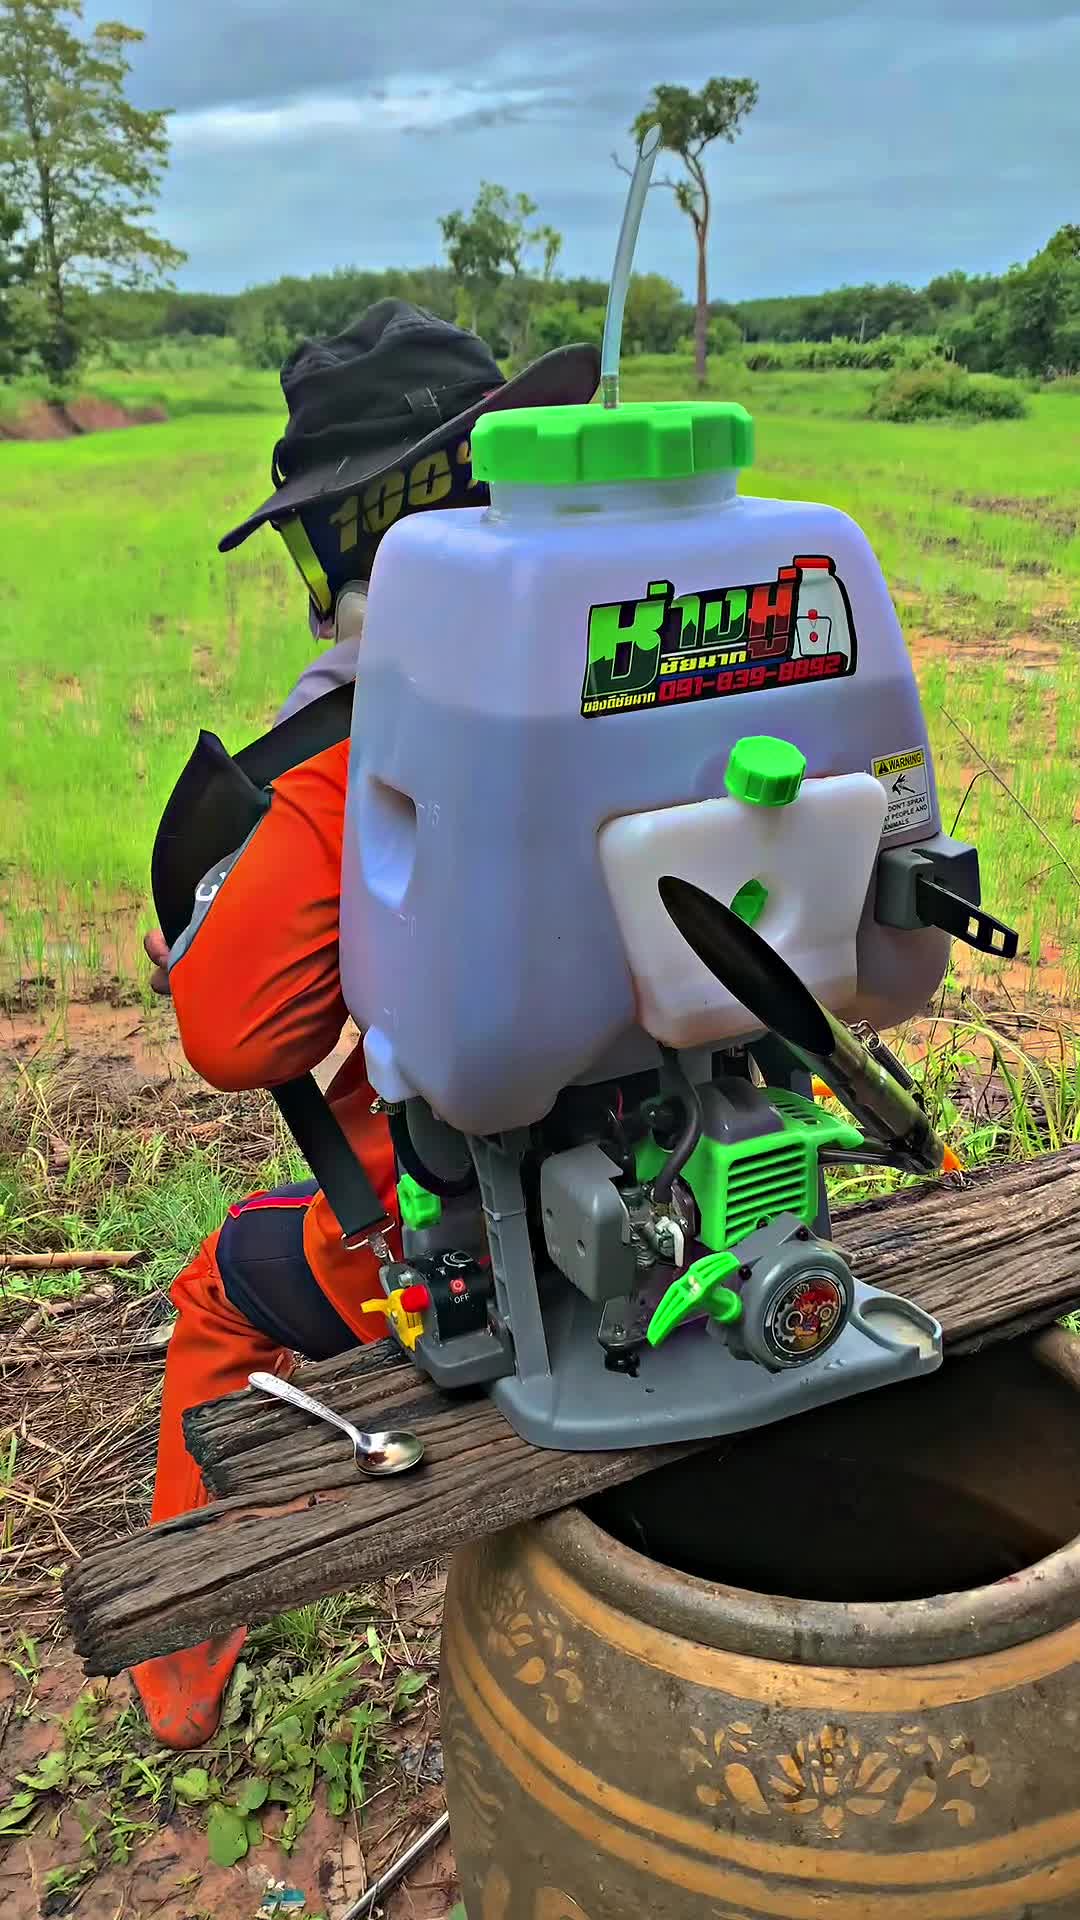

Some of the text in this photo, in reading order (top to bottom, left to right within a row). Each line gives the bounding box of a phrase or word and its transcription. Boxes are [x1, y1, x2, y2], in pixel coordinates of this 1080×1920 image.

[888, 753, 921, 770] WARNING
[888, 796, 925, 812] DON'T SPRAY
[891, 807, 914, 819] PEOPLE
[915, 804, 928, 812] AND
[883, 818, 910, 831] ANIMALS
[454, 1293, 470, 1304] OFF
